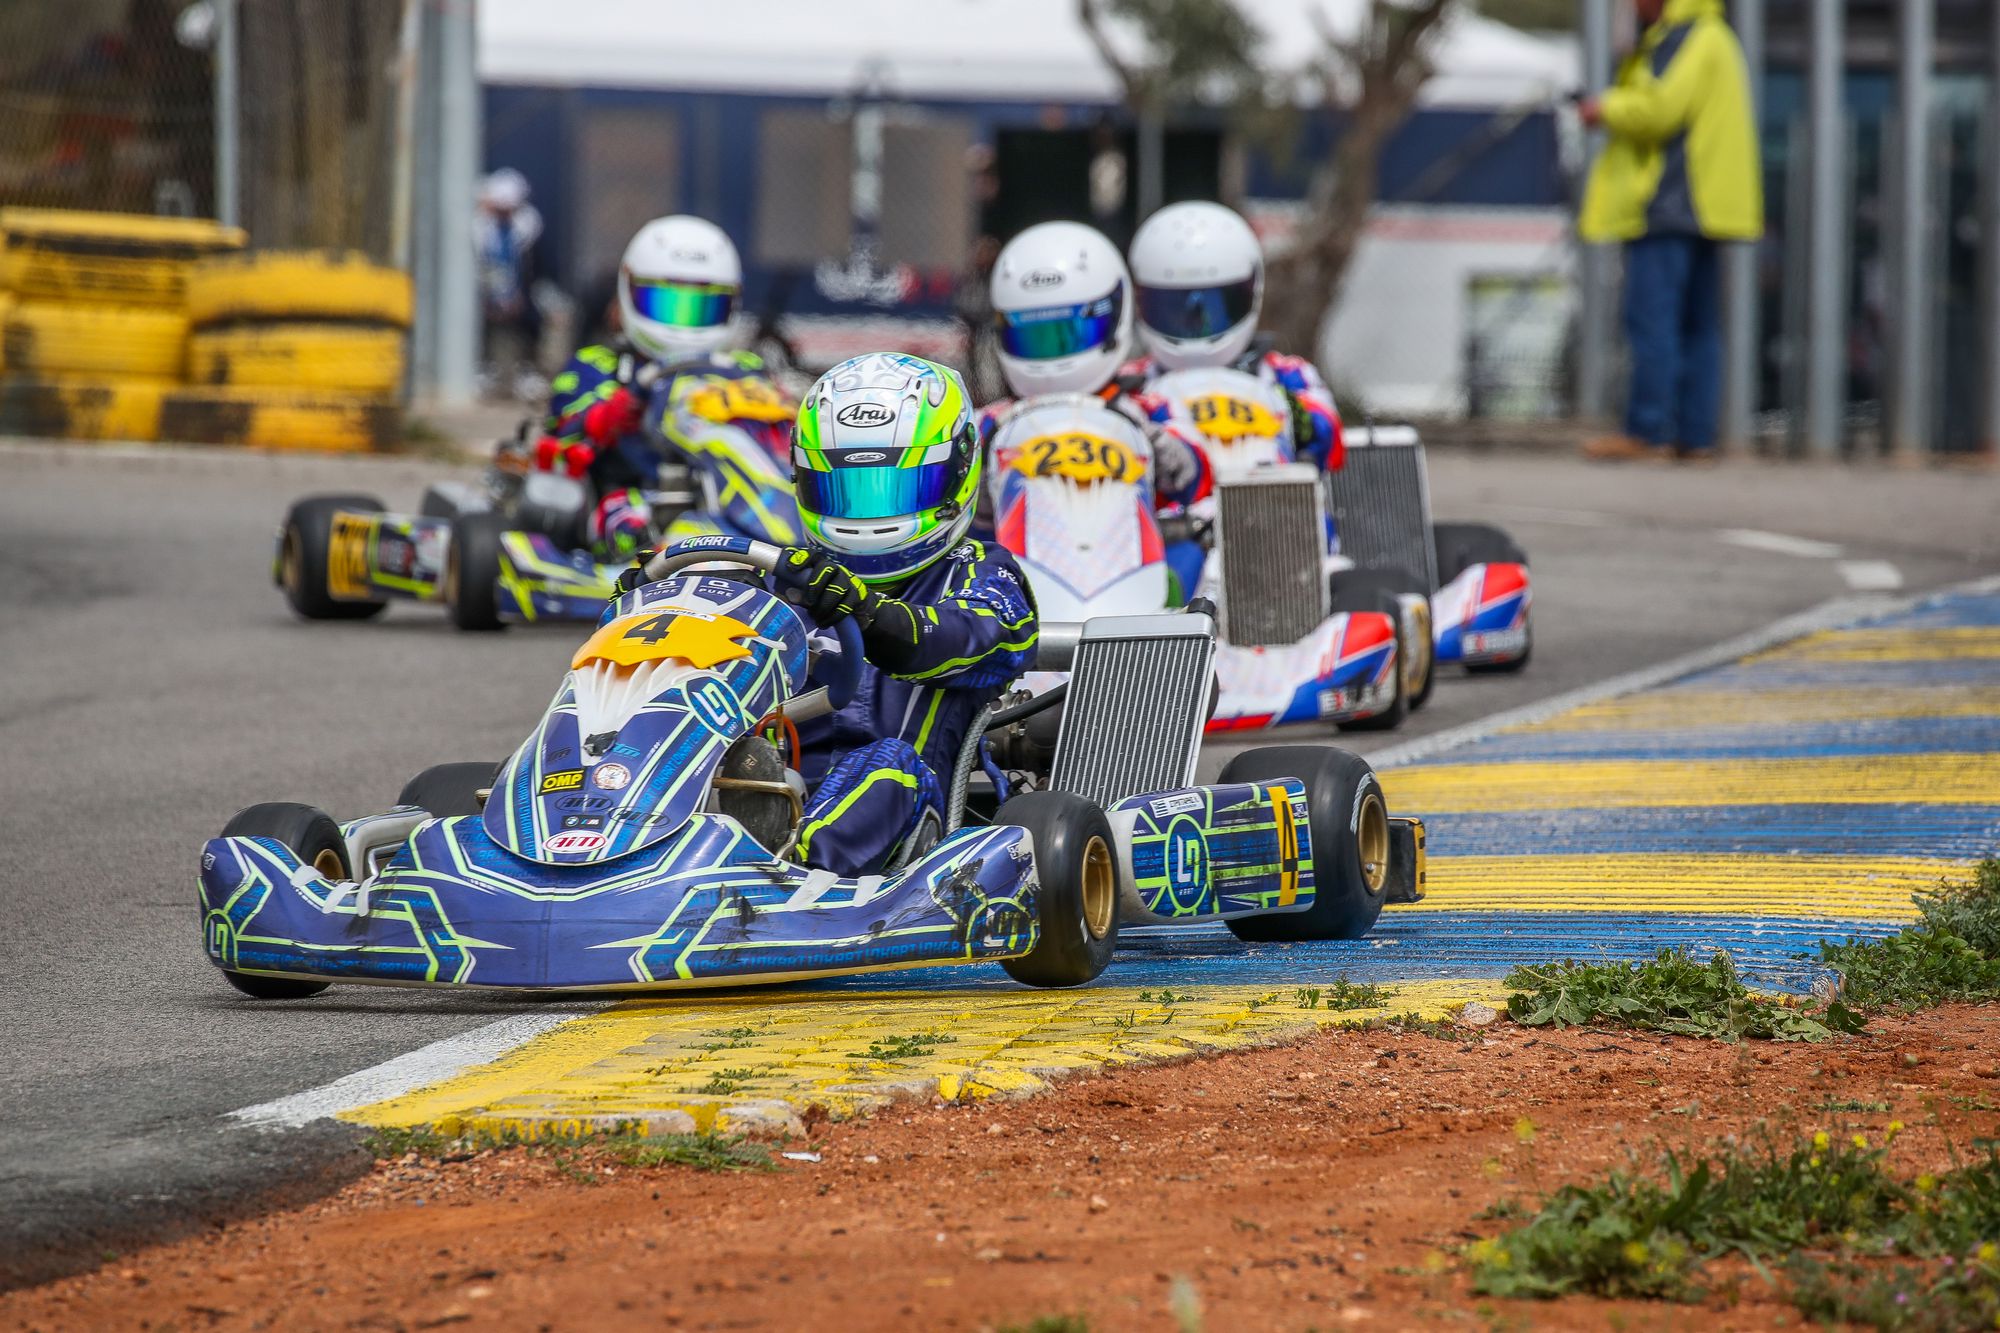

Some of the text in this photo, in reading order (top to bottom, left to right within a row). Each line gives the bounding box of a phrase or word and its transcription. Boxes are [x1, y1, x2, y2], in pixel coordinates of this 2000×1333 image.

[840, 405, 888, 421] Arai
[1033, 438, 1126, 479] 230
[645, 588, 678, 598] PURE
[698, 588, 733, 598] PURE
[623, 615, 679, 646] 4
[543, 773, 583, 789] OMP
[1282, 801, 1298, 889] 4
